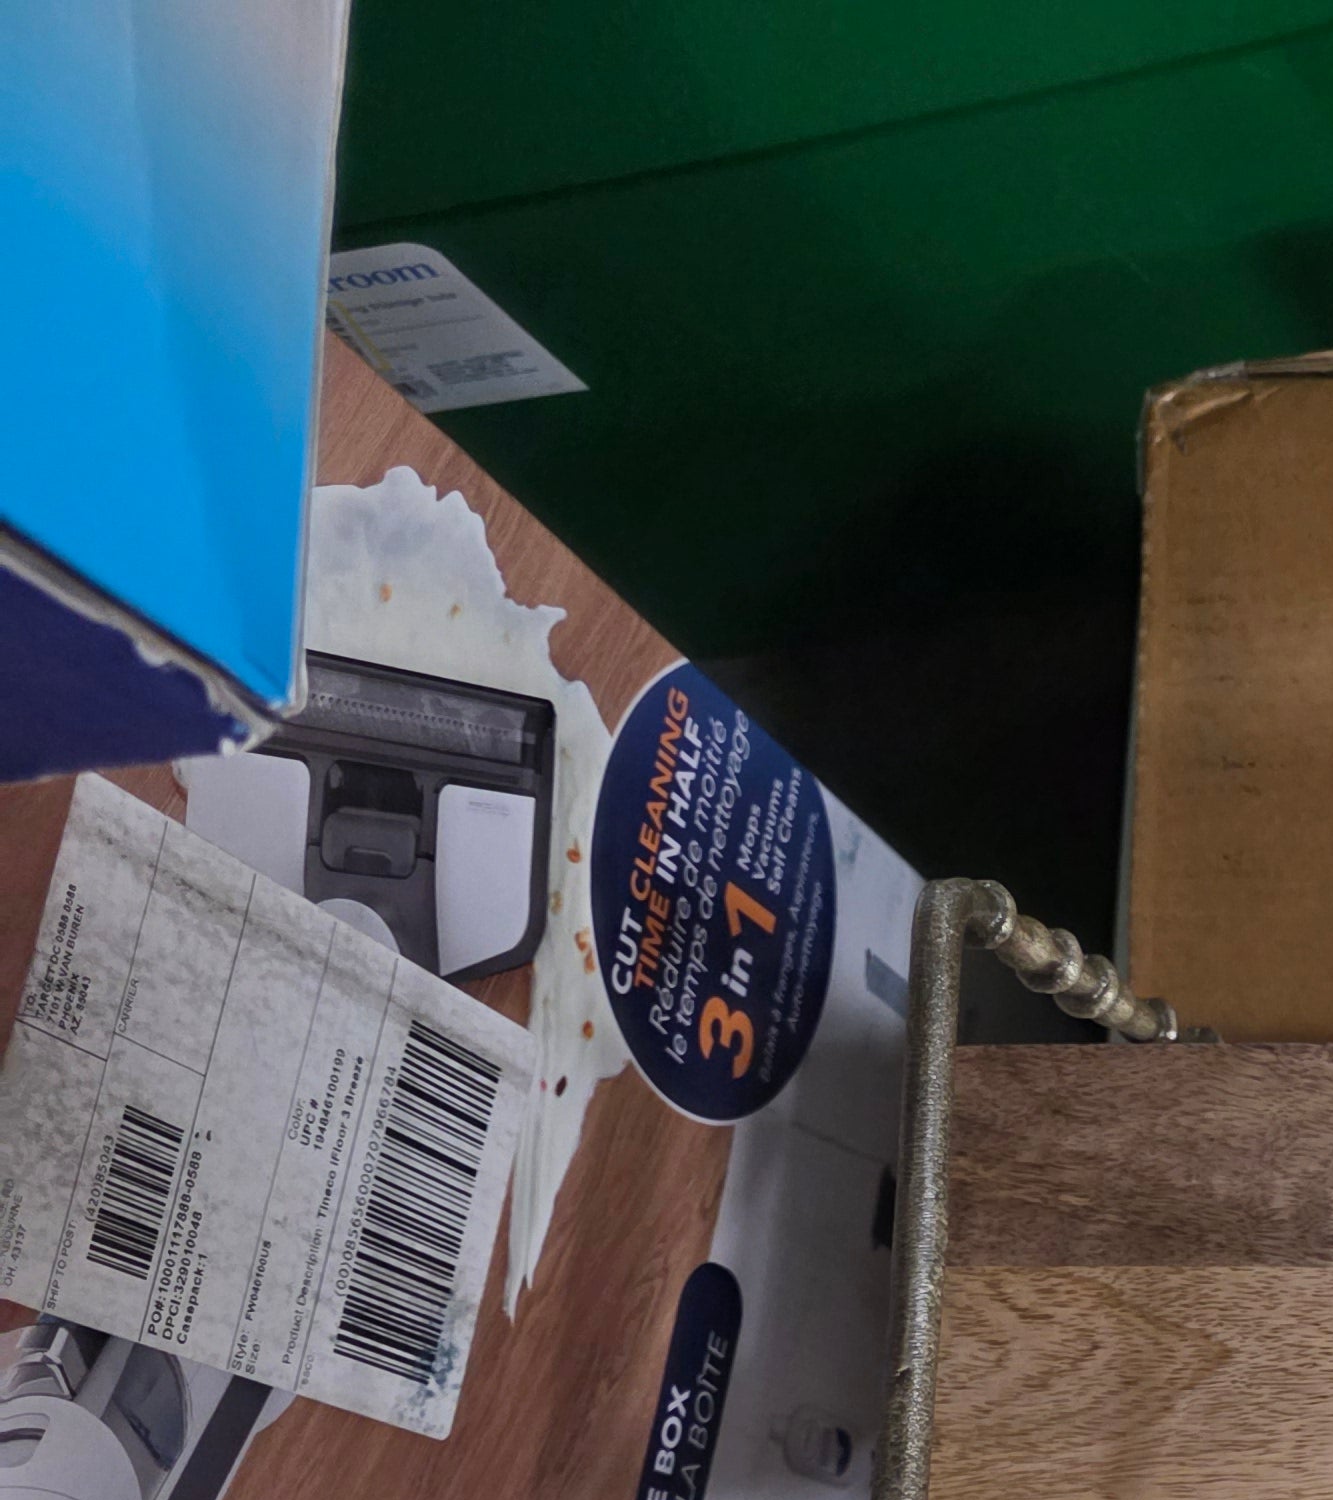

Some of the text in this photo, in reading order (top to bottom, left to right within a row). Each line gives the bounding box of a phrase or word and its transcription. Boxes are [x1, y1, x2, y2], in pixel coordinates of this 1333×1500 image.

[612, 686, 690, 995] CUT CLEANING
[635, 717, 703, 989] TIME IN HALF
[648, 716, 730, 1035] Réduire de moitié
[736, 804, 762, 872] Mops
[752, 778, 786, 882] Vacuums
[766, 768, 803, 895] Self Cleans
[664, 709, 749, 1064] le temps de nettoyage
[35, 963, 56, 1018] TARGET
[49, 945, 61, 964] DC
[47, 994, 61, 1024] 7101
[58, 949, 73, 978] VAN
[66, 903, 85, 949] BUREN
[58, 971, 80, 1030] PHOENIX
[75, 975, 91, 1011] 85043
[700, 881, 778, 1079] 3 in 1
[286, 1097, 306, 1141] Color:
[299, 1097, 319, 1146] UPC #
[339, 1107, 351, 1119] 3
[342, 1052, 365, 1107] Breeze
[83, 1133, 116, 1223] (420)85043
[332, 1063, 398, 1298] (00)085656000707966784
[9, 1223, 27, 1261] 43137
[45, 1216, 79, 1311] SHIP TO POST:
[147, 1149, 202, 1336] PO#:10001117888-0588
[161, 1209, 203, 1341] DPCI:329010048
[294, 1223, 325, 1307] Description:
[175, 1251, 209, 1346] Casepack:1
[281, 1308, 305, 1365] Product
[231, 1328, 252, 1371] Style:
[244, 1337, 262, 1375] Size:
[686, 1331, 728, 1452] BOÎTE
[654, 1385, 692, 1477] BOX
